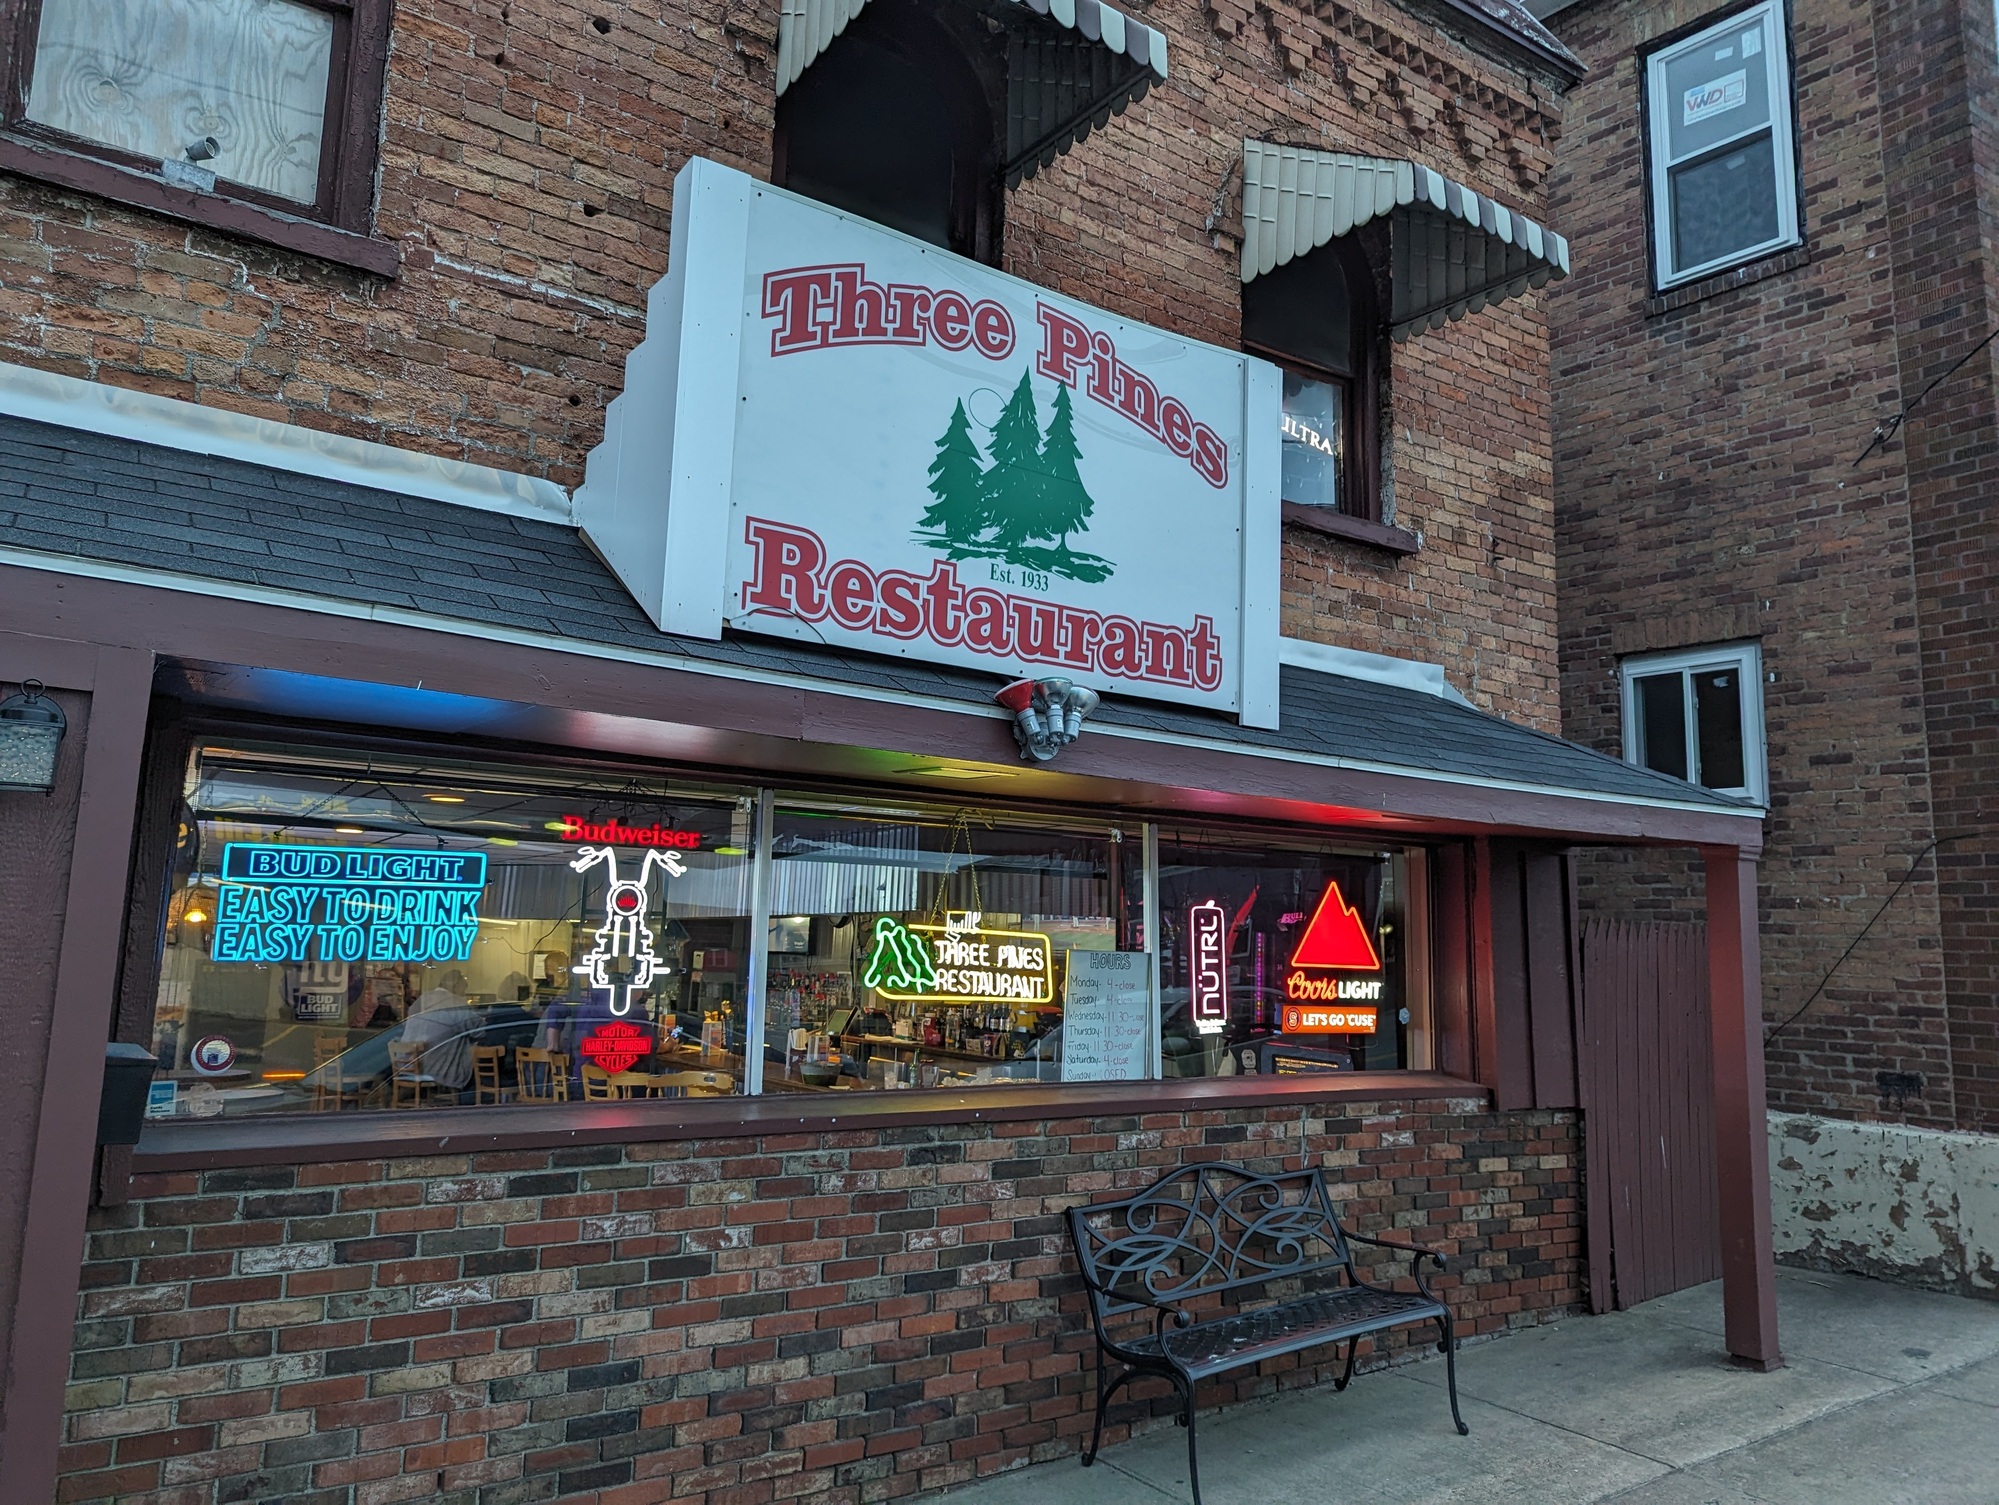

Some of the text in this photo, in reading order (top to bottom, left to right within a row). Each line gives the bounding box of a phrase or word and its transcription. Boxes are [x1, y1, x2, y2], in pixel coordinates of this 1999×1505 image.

[761, 263, 1229, 489] Three Pines
[990, 563, 1049, 592] Est. 1933
[742, 515, 1222, 692] Restaurant
[561, 815, 701, 849] Budweiser
[250, 850, 464, 881] BUD LIGHT
[218, 885, 481, 926] EASY TO DRINK
[214, 923, 479, 961] EASY TO ENJOY
[934, 940, 1044, 971] THREE PINES
[1090, 953, 1132, 970] HOURS
[934, 968, 1045, 999] RESTAURANT
[1287, 970, 1382, 1000] Coors LIGHT
[300, 1003, 340, 1013] LIGHT
[306, 995, 334, 1004] BUD
[601, 1026, 635, 1038] MOTOR
[1302, 1013, 1328, 1026] LET'S
[1328, 1013, 1345, 1026] GO
[585, 1039, 648, 1053] HARLEY-DAVIDSON
[599, 1054, 633, 1070] CYCLES
